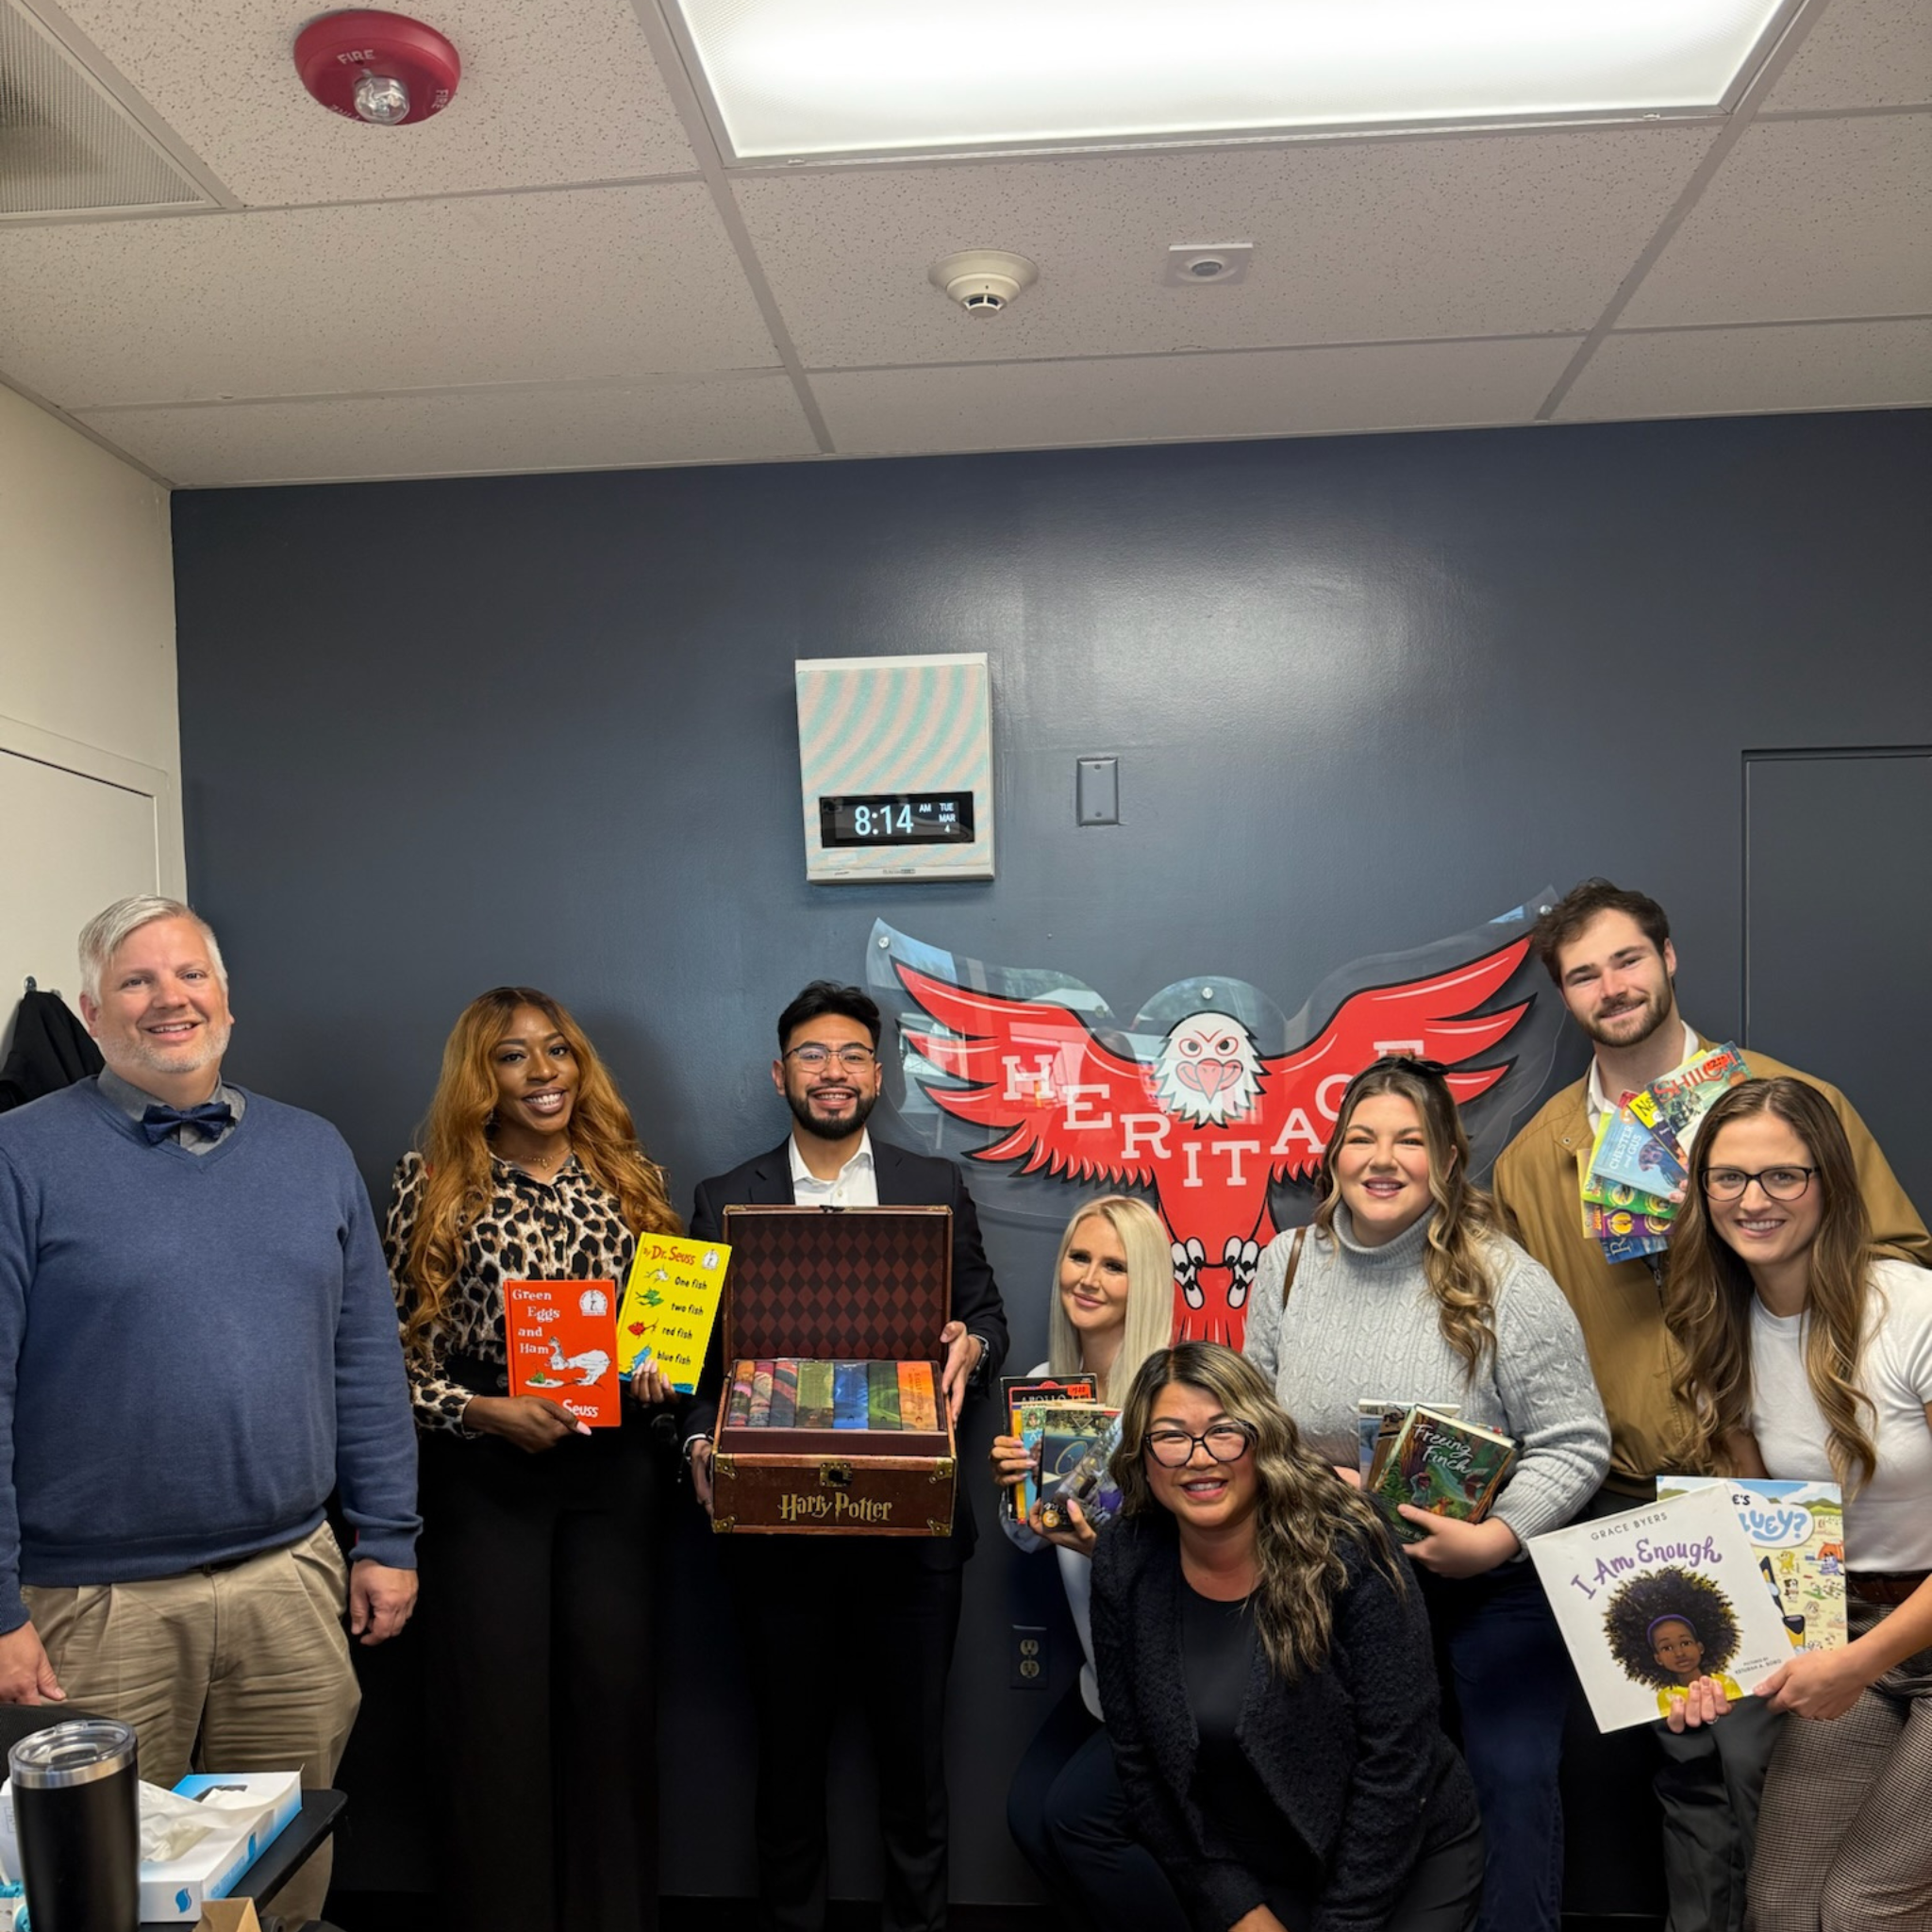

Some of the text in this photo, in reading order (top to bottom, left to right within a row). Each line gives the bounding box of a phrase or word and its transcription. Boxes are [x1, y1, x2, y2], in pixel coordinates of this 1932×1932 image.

[337, 49, 375, 64] FIRE
[940, 802, 955, 811] TUE
[855, 803, 932, 836] 8:14 AM
[939, 813, 956, 823] MAR
[944, 824, 951, 833] 4
[1609, 1125, 1634, 1170] CHESTER
[1627, 1134, 1642, 1155] GUS
[651, 1245, 666, 1259] Dr.
[668, 1246, 696, 1266] Seuss
[675, 1275, 708, 1290] One fish
[512, 1289, 552, 1301] Green
[527, 1307, 560, 1323] Eggs
[672, 1303, 704, 1315] two fish
[518, 1326, 543, 1338] and
[662, 1326, 692, 1340] red fish
[520, 1342, 549, 1355] Ham
[657, 1350, 691, 1365] blue fish
[562, 1399, 599, 1418] Seuss
[1414, 1424, 1474, 1458] Freeing
[1423, 1445, 1472, 1474] Finch
[777, 1491, 892, 1523] Harry Potter
[1591, 1512, 1668, 1541] GRACE BYERS
[1739, 1509, 1807, 1541] LUEY?
[1571, 1536, 1723, 1600] I Am Enough
